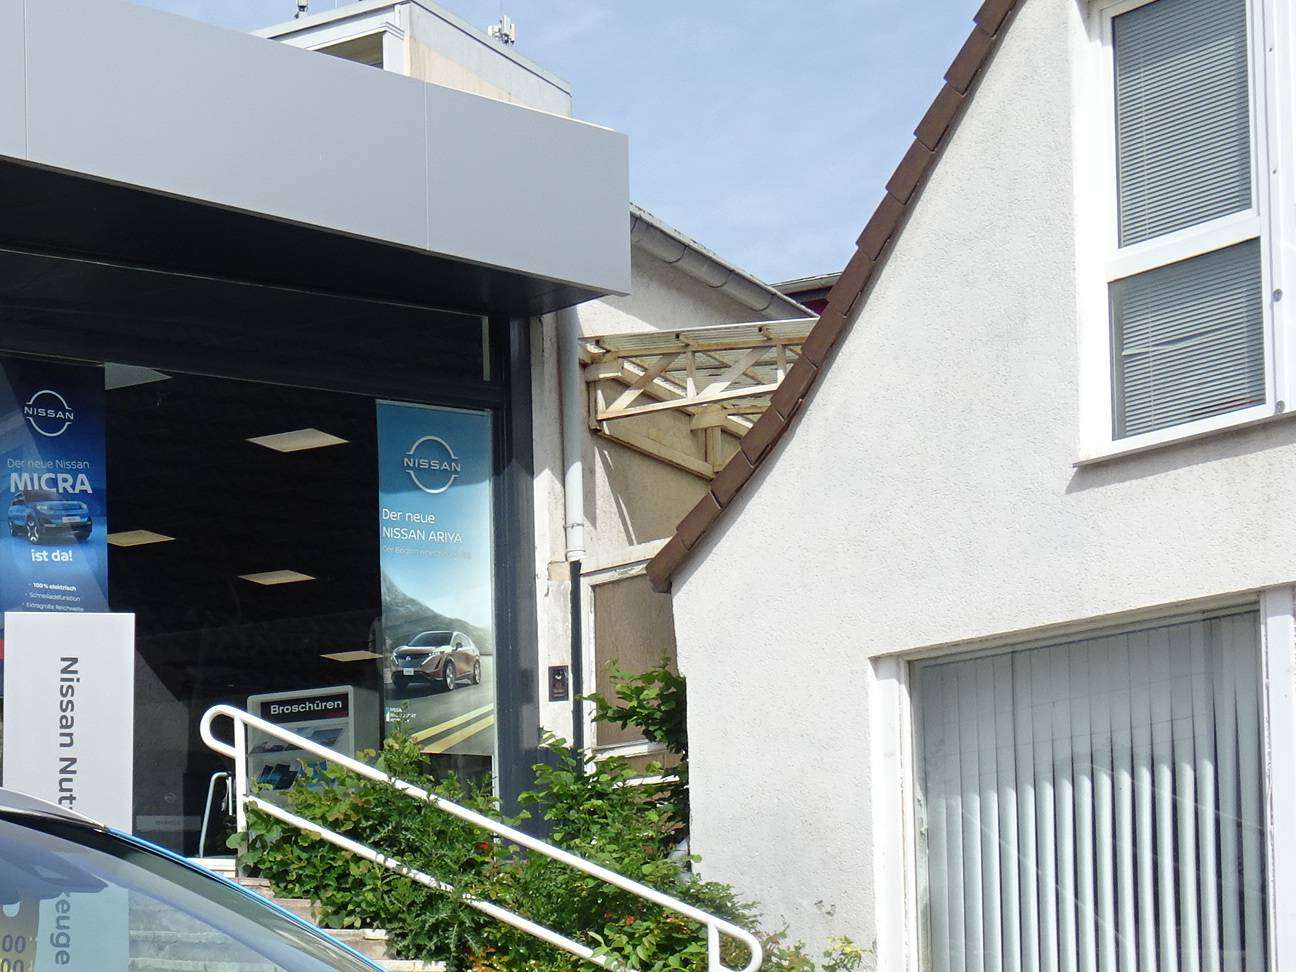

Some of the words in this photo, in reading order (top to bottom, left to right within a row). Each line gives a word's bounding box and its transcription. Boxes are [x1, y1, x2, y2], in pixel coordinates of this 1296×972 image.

[24, 406, 74, 420] NISSAN
[7, 458, 24, 468] Der
[27, 459, 53, 469] neue
[55, 459, 90, 470] Nissan
[404, 456, 461, 472] NISSAN
[10, 472, 93, 494] MICRA
[382, 508, 402, 521] Der
[405, 512, 436, 524] neue
[382, 526, 426, 541] NISSAN
[428, 531, 463, 544] ARIYA
[31, 549, 49, 562] ist
[51, 549, 73, 562] da!
[59, 656, 80, 748] Nissan
[270, 700, 342, 715] Broschüren
